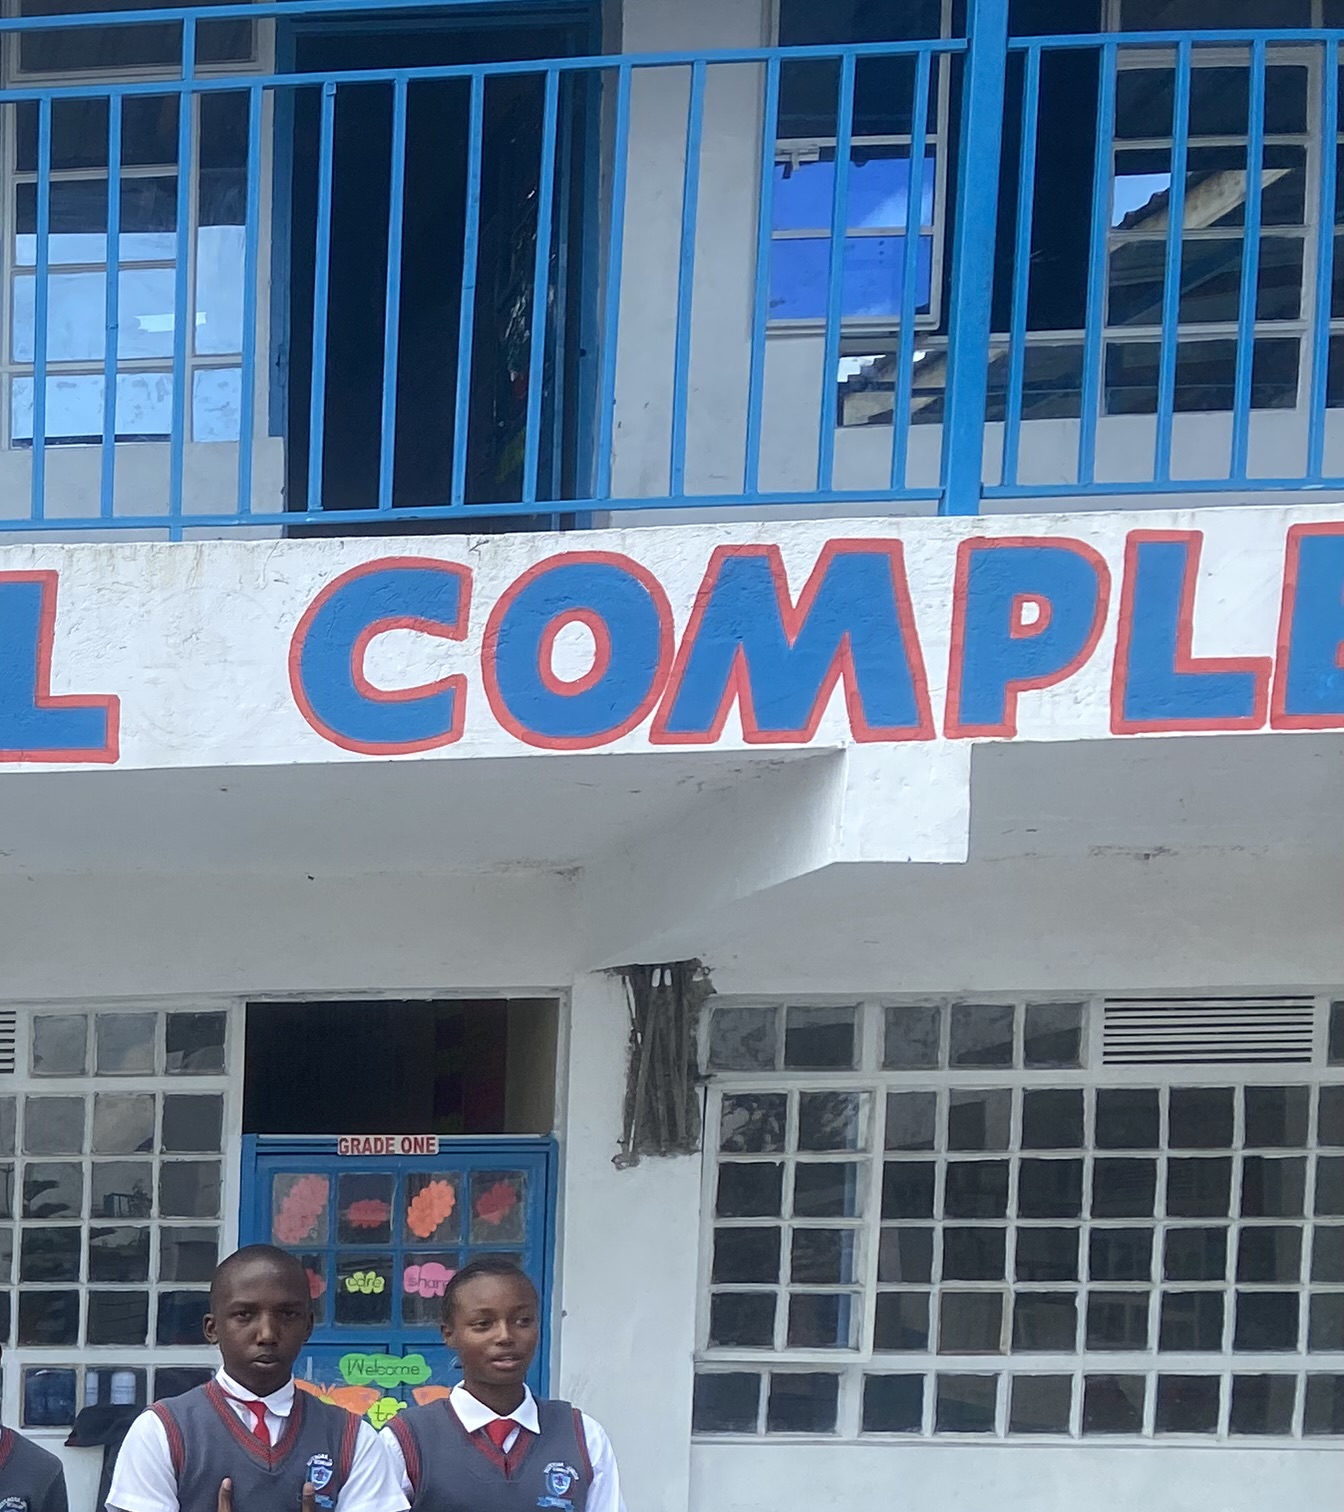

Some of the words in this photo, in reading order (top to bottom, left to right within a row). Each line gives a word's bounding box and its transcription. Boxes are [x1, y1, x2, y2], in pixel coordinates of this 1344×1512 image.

[338, 1136, 396, 1155] GRADE
[400, 1135, 436, 1154] ONE
[347, 1358, 420, 1377] Welcome
